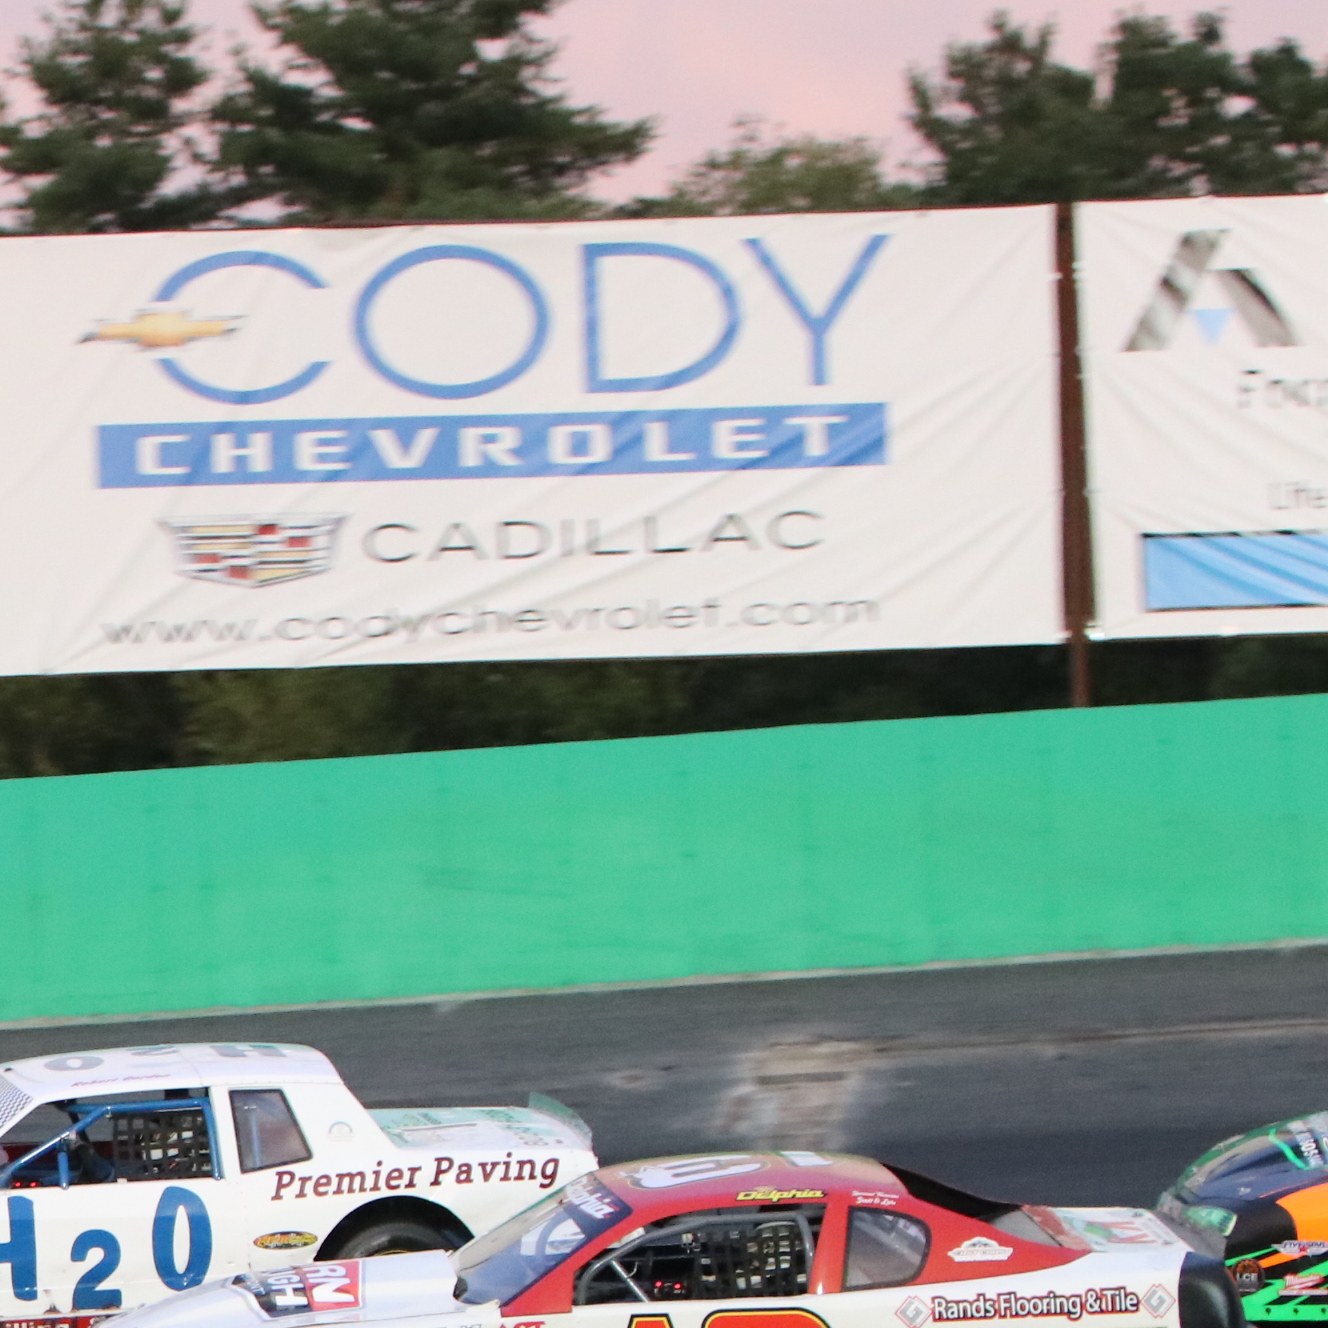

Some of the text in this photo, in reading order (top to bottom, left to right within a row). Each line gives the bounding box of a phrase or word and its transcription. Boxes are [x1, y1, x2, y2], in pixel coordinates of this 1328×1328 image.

[152, 233, 894, 405] CODY
[134, 414, 850, 477] CHEVROLET
[363, 509, 826, 564] CADILLAC
[98, 596, 881, 648] www.codychevrolet.com
[271, 1152, 560, 1201] Premier Paving
[933, 1288, 1139, 1320] Rands Flooring & Tile
